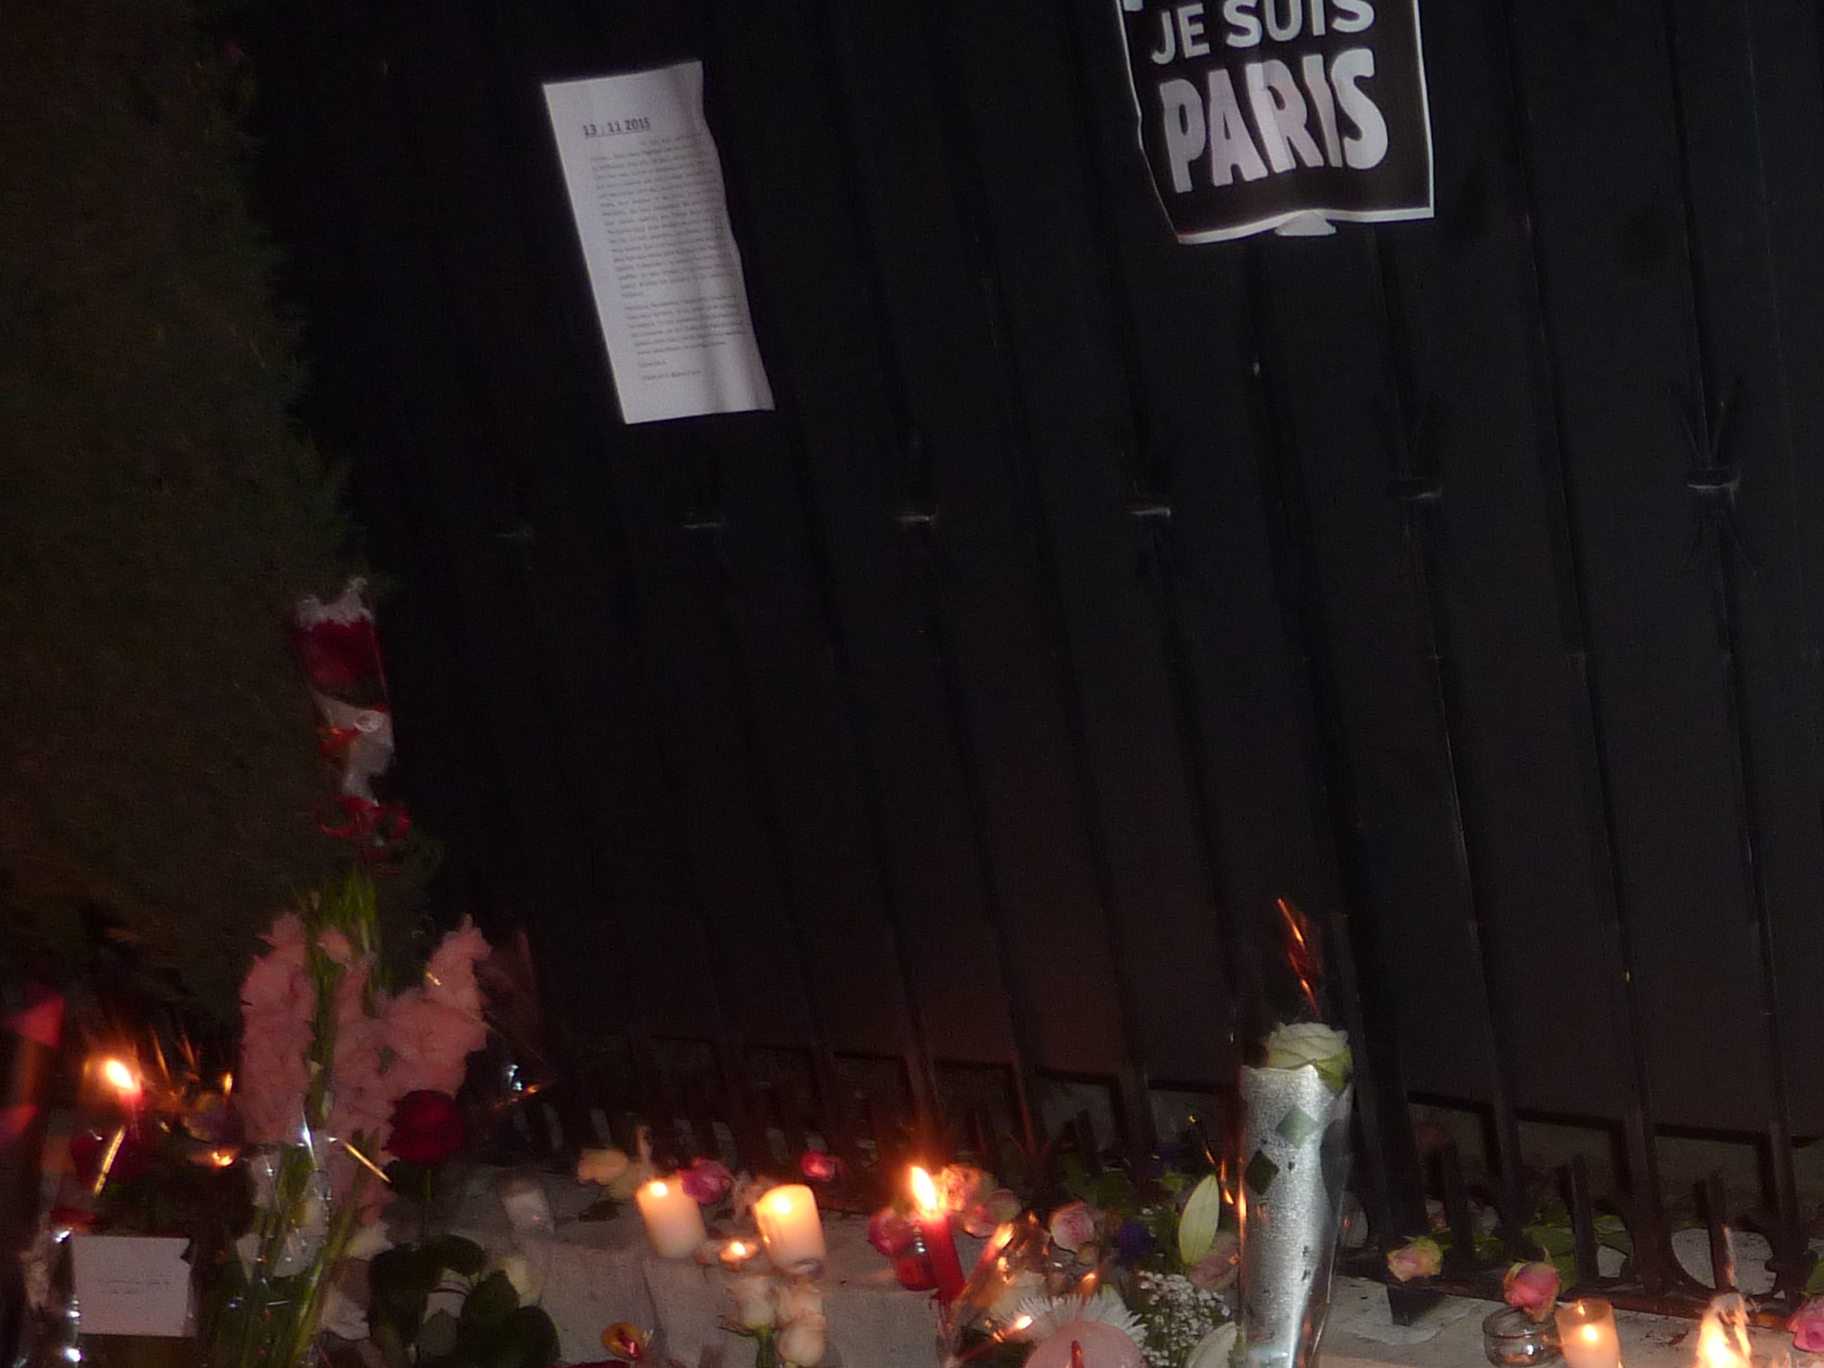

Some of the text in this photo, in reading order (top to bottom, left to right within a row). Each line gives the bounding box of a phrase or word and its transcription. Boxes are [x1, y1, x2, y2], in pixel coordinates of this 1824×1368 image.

[1151, 0, 1375, 65] JE SUIS
[1159, 47, 1389, 194] PARIS
